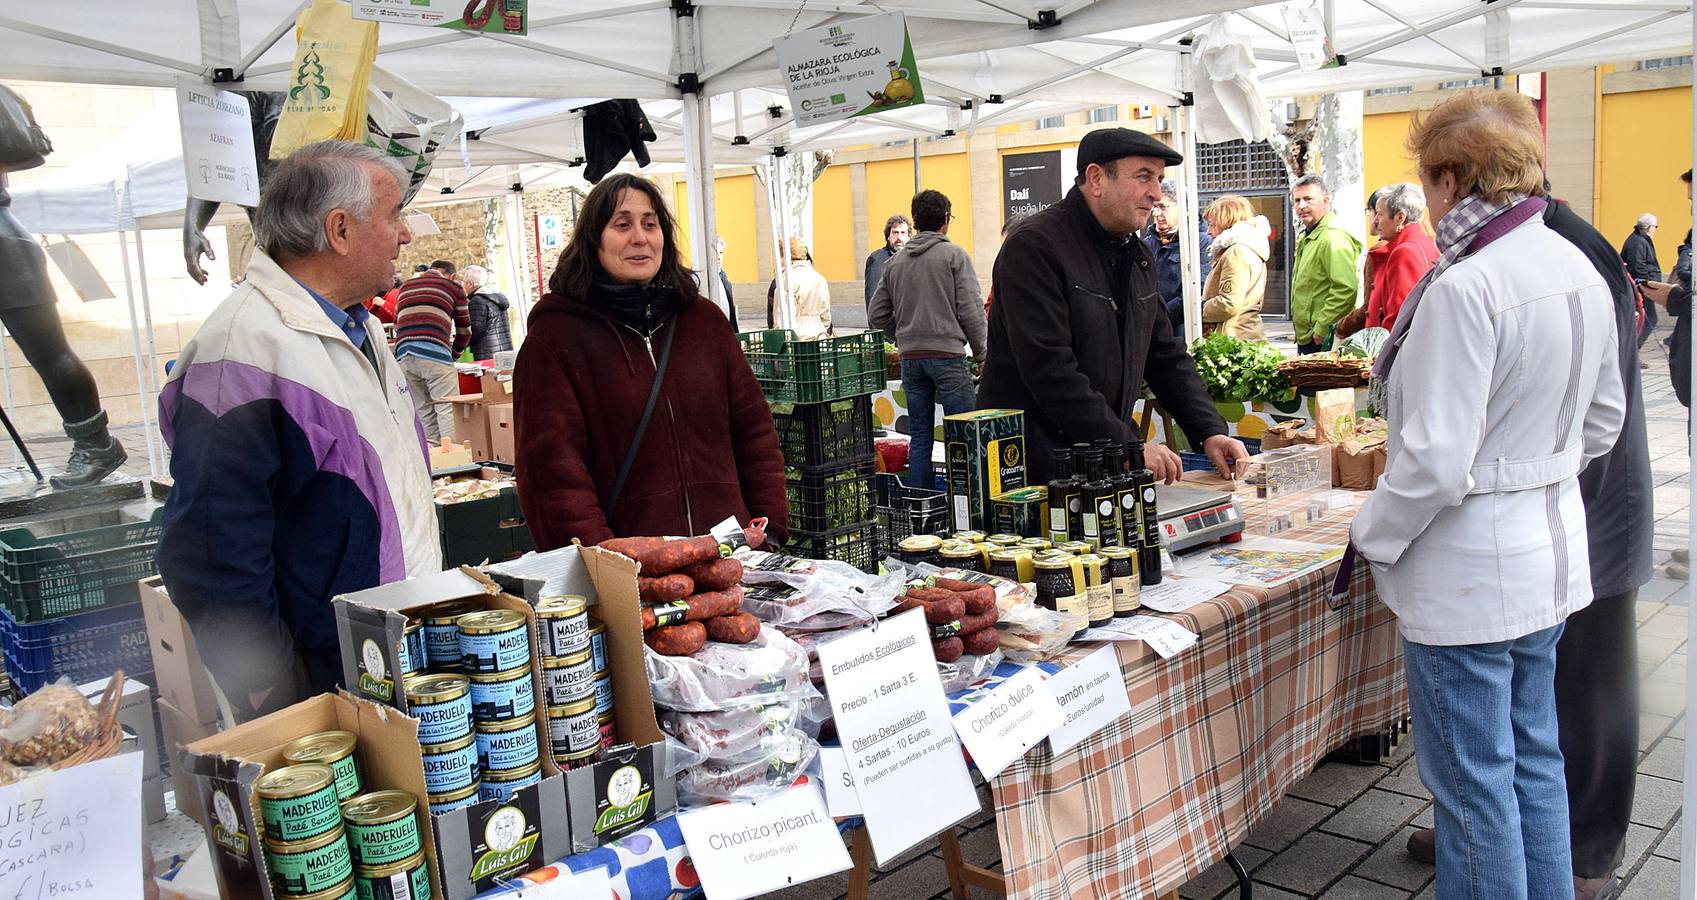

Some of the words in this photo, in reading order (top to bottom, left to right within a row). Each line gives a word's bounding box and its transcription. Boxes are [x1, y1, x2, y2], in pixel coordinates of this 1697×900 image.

[788, 58, 831, 73] ALMAZARA
[832, 47, 881, 63] ECOLÓGICA
[790, 73, 801, 82] DE
[804, 71, 814, 79] LA
[815, 65, 840, 78] RIOJA
[793, 82, 811, 91] Aceite
[821, 77, 837, 86] Oliva
[838, 73, 857, 83] Virgen
[858, 69, 874, 78] Extra
[189, 91, 214, 109] LETICIA
[1010, 187, 1030, 200] Dalí
[1011, 202, 1036, 215] sueña
[1038, 201, 1052, 212] lo
[832, 653, 875, 676] Embutidos
[875, 633, 916, 659] Ecológicos
[363, 678, 378, 694] Luis
[379, 683, 390, 697] Gil
[556, 685, 573, 696] Paté
[841, 696, 867, 713] Precio
[880, 679, 902, 696] Sarta
[902, 675, 908, 686] 3
[909, 672, 918, 683] E.
[1085, 681, 1093, 691] en
[1092, 671, 1110, 689] tacos
[971, 704, 1008, 734] Chorizo
[1008, 683, 1034, 708] dulce
[1067, 694, 1105, 723] Euros/unidad
[852, 709, 927, 751] Oferta-Degustación
[858, 759, 864, 769] 4
[865, 747, 891, 766] Sartas
[896, 737, 907, 750] 10
[908, 728, 931, 745] Euros
[863, 766, 889, 788] (Pueden
[889, 762, 899, 773] ser
[900, 751, 922, 768] surtidas
[928, 743, 935, 753] su
[936, 734, 954, 752] gusto)
[282, 790, 337, 819] MADERUELO
[602, 810, 626, 829] Luis
[627, 798, 644, 818] Gil
[286, 819, 308, 832] Paté
[310, 809, 339, 828] Serrano
[361, 819, 416, 845] MADERUELO
[708, 824, 770, 851] Chorizo
[772, 809, 823, 838] picant.
[367, 846, 386, 856] Paté
[388, 839, 415, 854] Serrano
[480, 854, 507, 875] Luis
[509, 841, 530, 863] Gil
[749, 847, 779, 864] Cuerda
[779, 843, 799, 857] roja)
[49, 878, 94, 897] BOLSA
[312, 871, 333, 882] Paté
